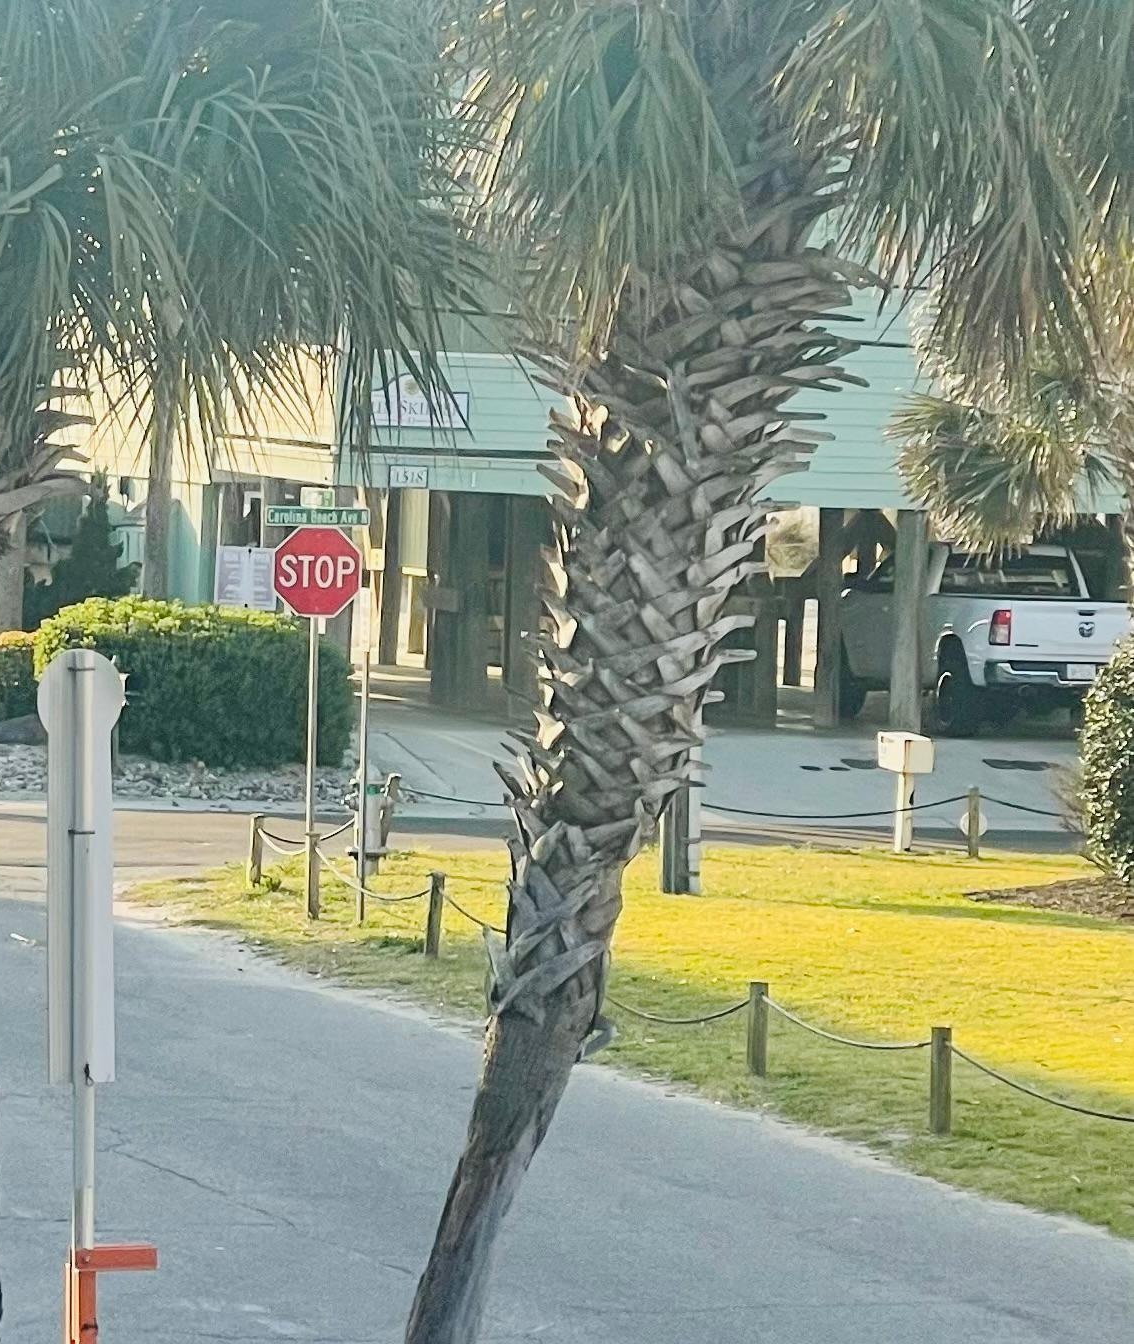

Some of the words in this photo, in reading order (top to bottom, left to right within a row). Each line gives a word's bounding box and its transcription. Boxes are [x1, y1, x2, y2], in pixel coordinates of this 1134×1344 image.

[268, 509, 308, 524] Carolina
[311, 510, 338, 524] Beach
[340, 511, 358, 524] Ave
[279, 554, 356, 589] STOP
